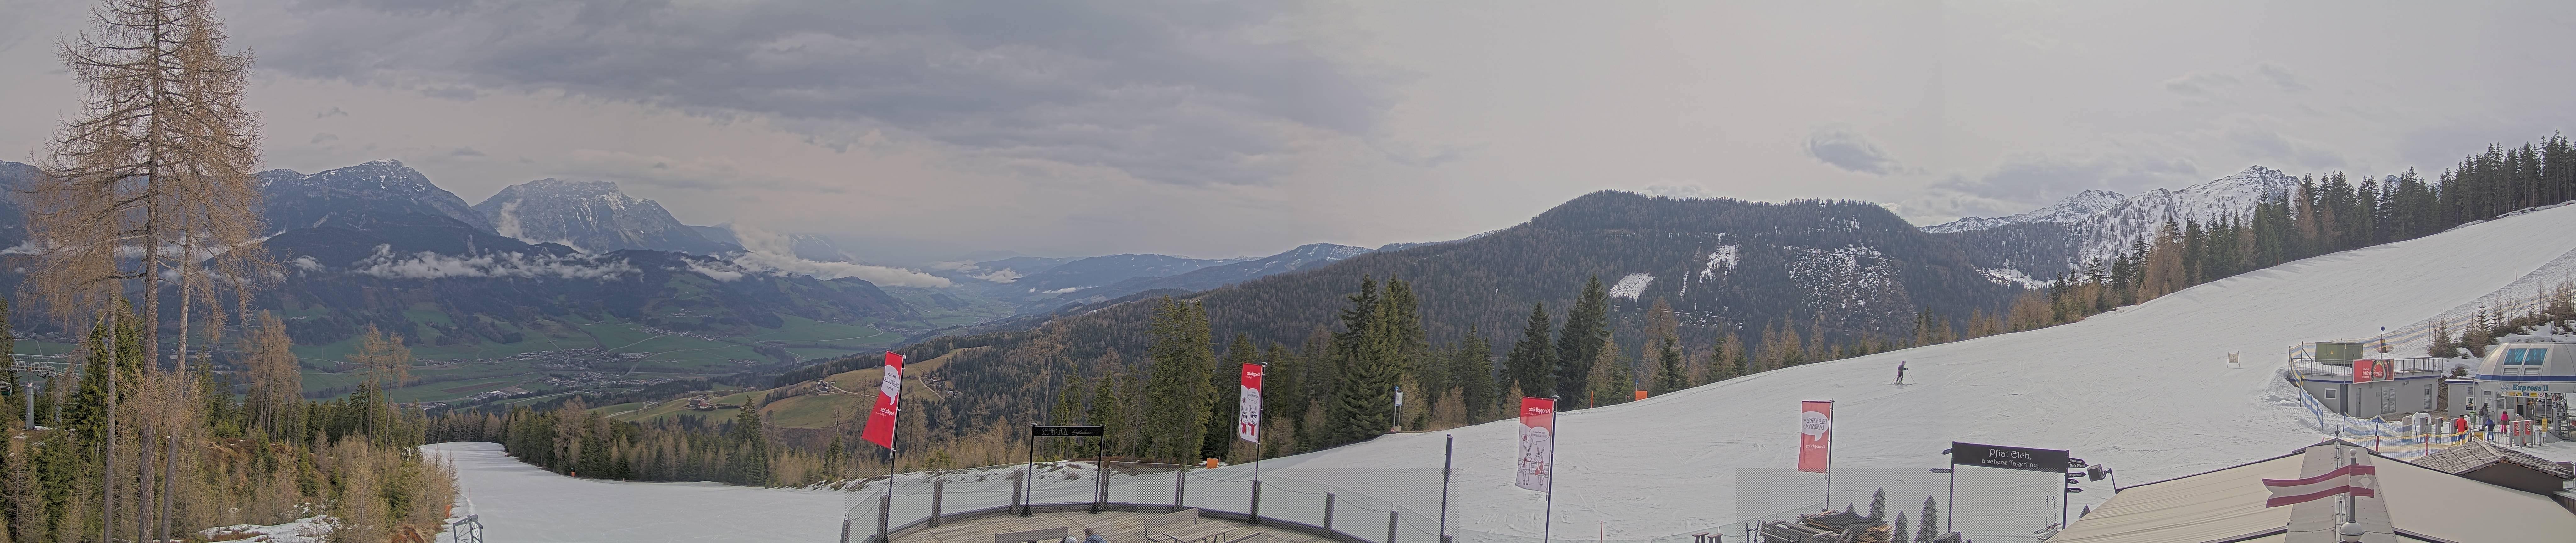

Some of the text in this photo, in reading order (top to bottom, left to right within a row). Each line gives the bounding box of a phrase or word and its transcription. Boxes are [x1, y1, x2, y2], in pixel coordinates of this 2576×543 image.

[2512, 384, 2542, 392] Express
[1989, 449, 2032, 460] Pfiat Eich,
